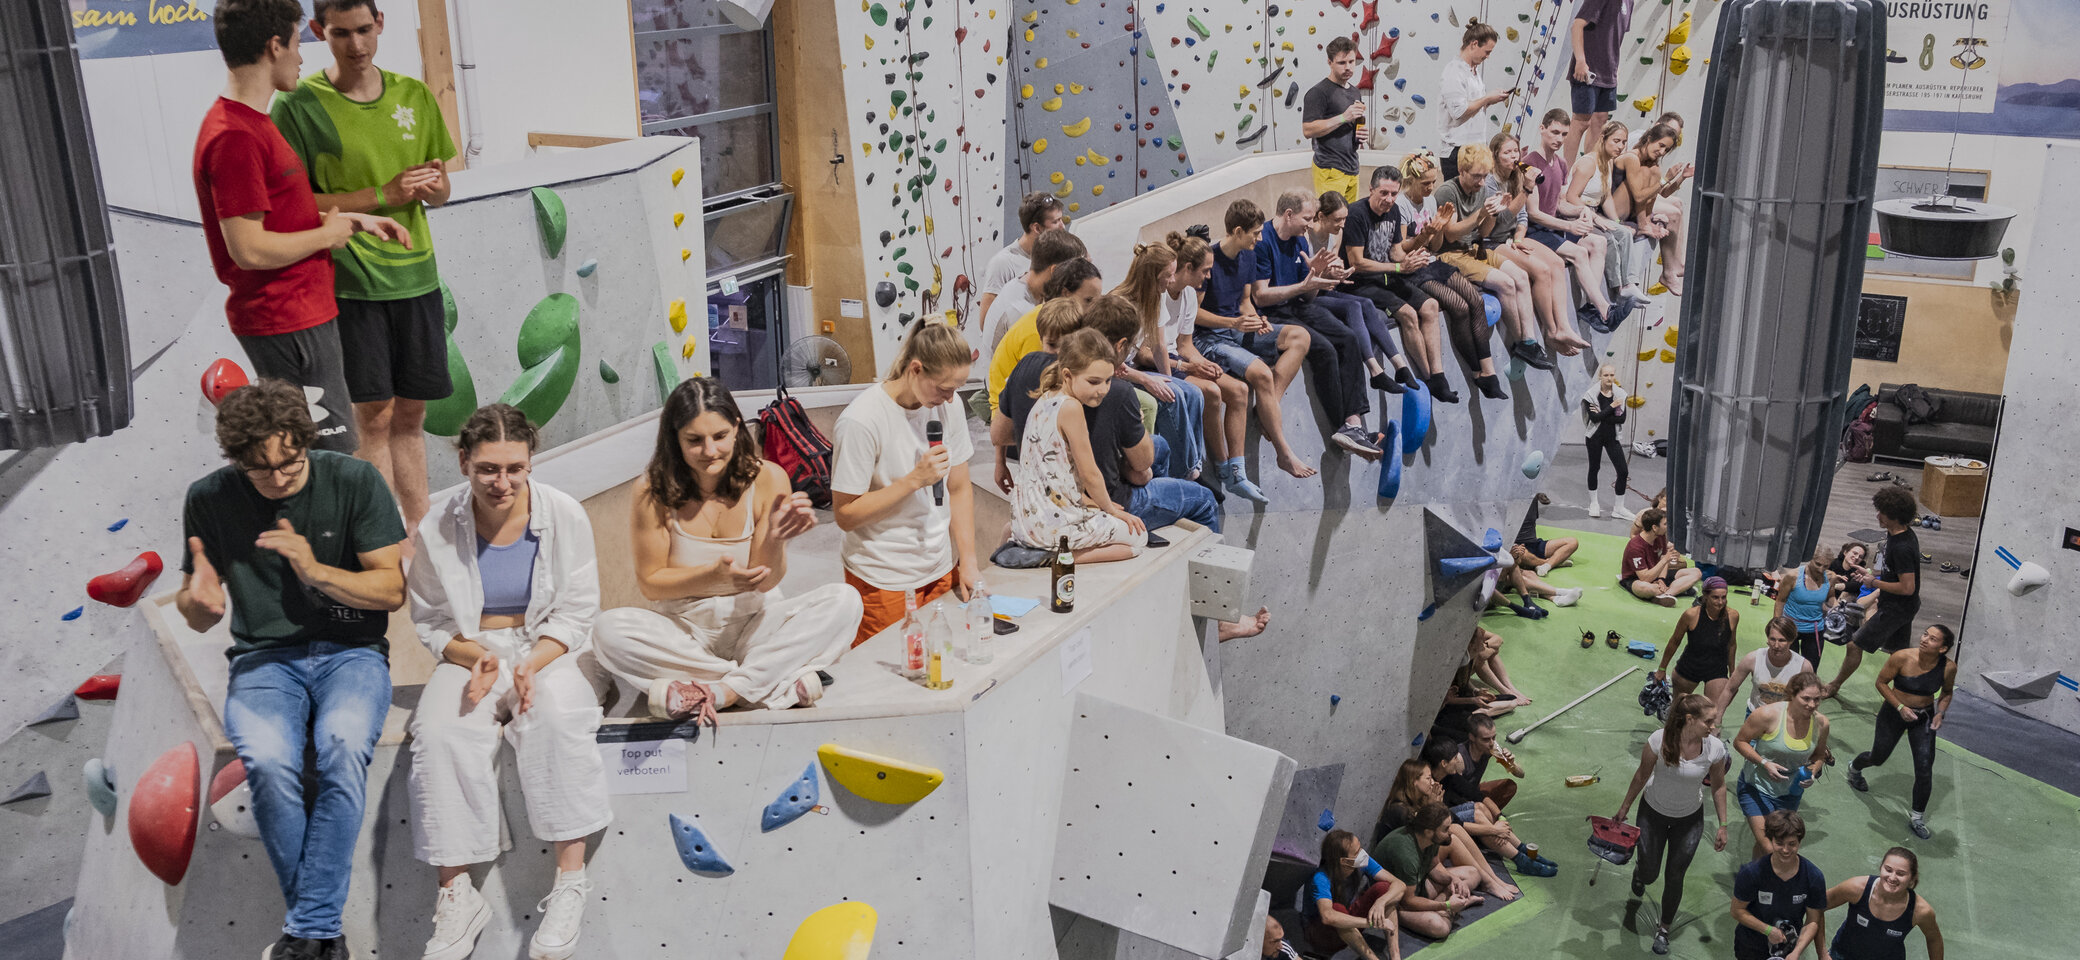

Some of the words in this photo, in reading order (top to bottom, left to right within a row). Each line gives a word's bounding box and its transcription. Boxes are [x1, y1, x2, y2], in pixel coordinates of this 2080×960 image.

[1887, 0, 1989, 20] USRÜSTUNG
[72, 9, 137, 28] sam
[1892, 180, 1939, 195] SCHWER
[621, 748, 642, 759] Top
[644, 748, 663, 758] out
[616, 764, 671, 776] verboten!
